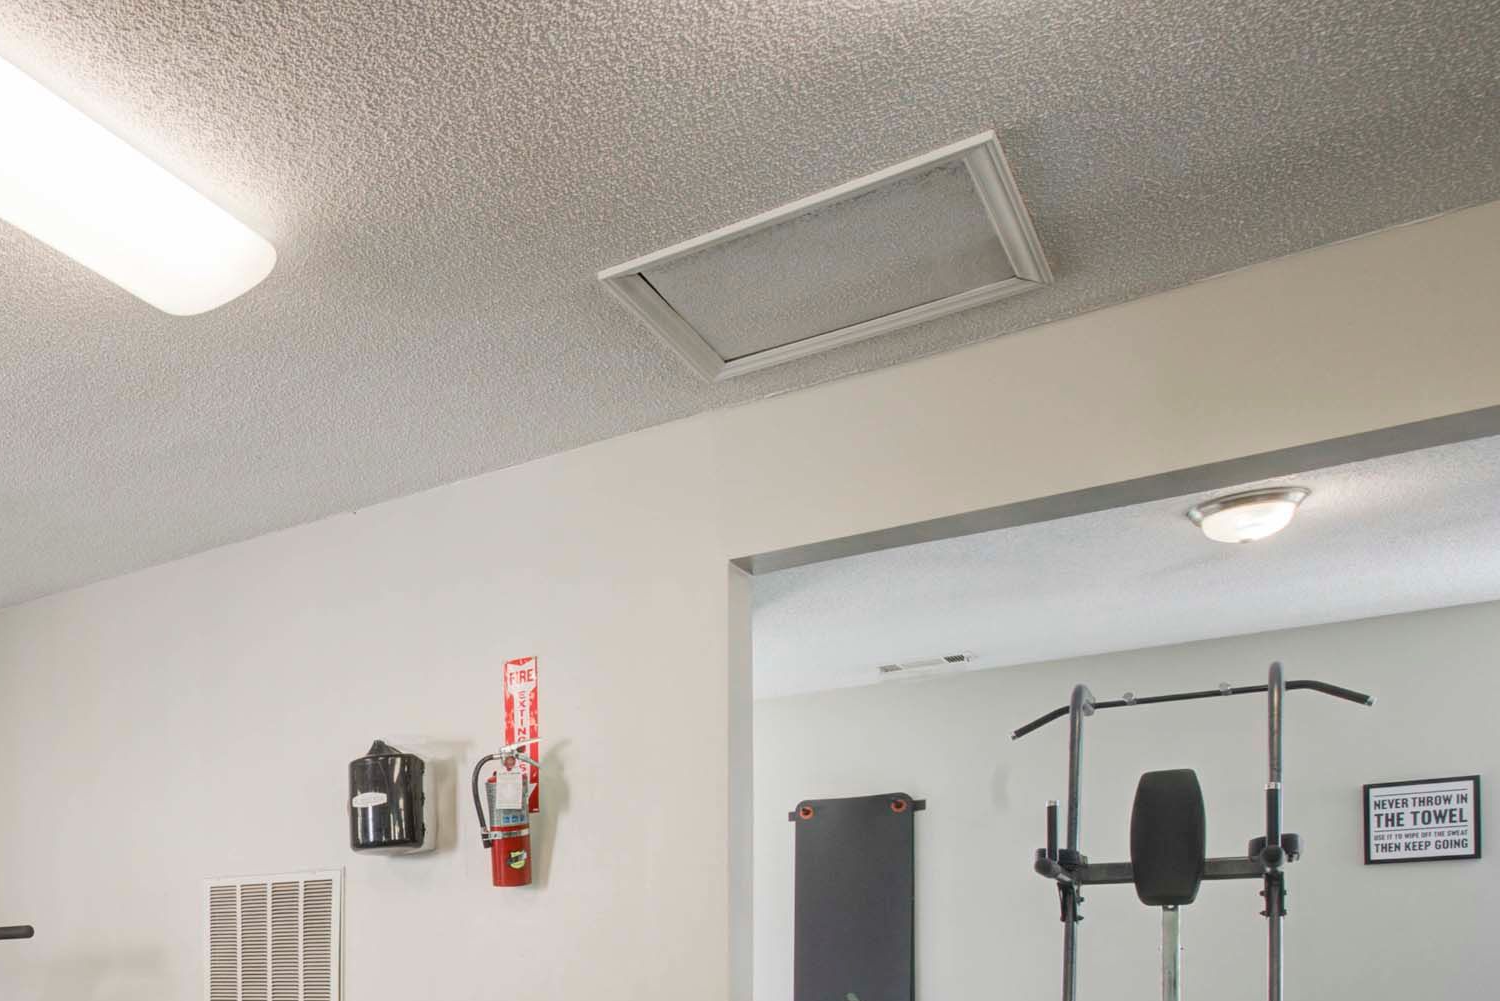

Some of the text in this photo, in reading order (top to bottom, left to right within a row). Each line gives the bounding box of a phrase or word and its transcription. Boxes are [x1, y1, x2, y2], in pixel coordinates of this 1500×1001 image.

[509, 668, 534, 685] FIRE
[1374, 793, 1468, 810] NEVER THROW IN
[1374, 808, 1468, 828] THE TOWEL
[1447, 829, 1468, 837] SWEAT
[1374, 838, 1468, 853] THEN KEEP GOING
